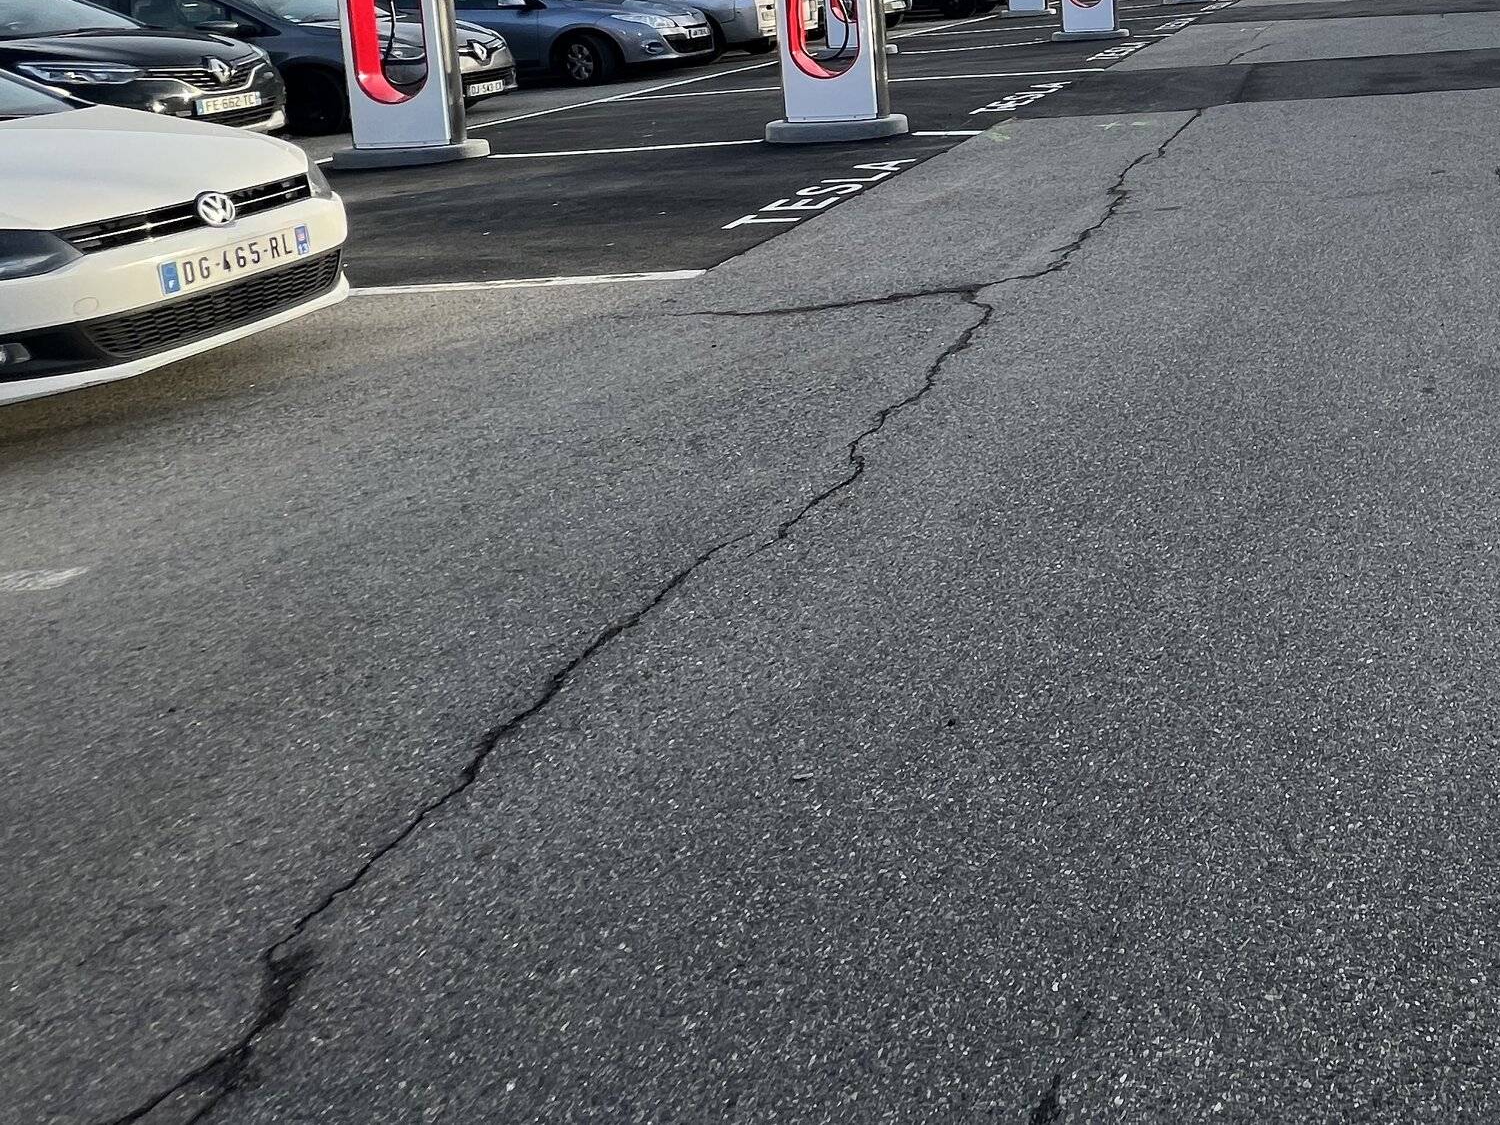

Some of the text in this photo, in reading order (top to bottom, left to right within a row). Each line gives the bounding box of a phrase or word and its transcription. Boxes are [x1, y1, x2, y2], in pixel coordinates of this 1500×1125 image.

[969, 80, 1073, 116] TESLA
[721, 158, 917, 231] TESLA
[183, 233, 293, 286] DG-465-RL
